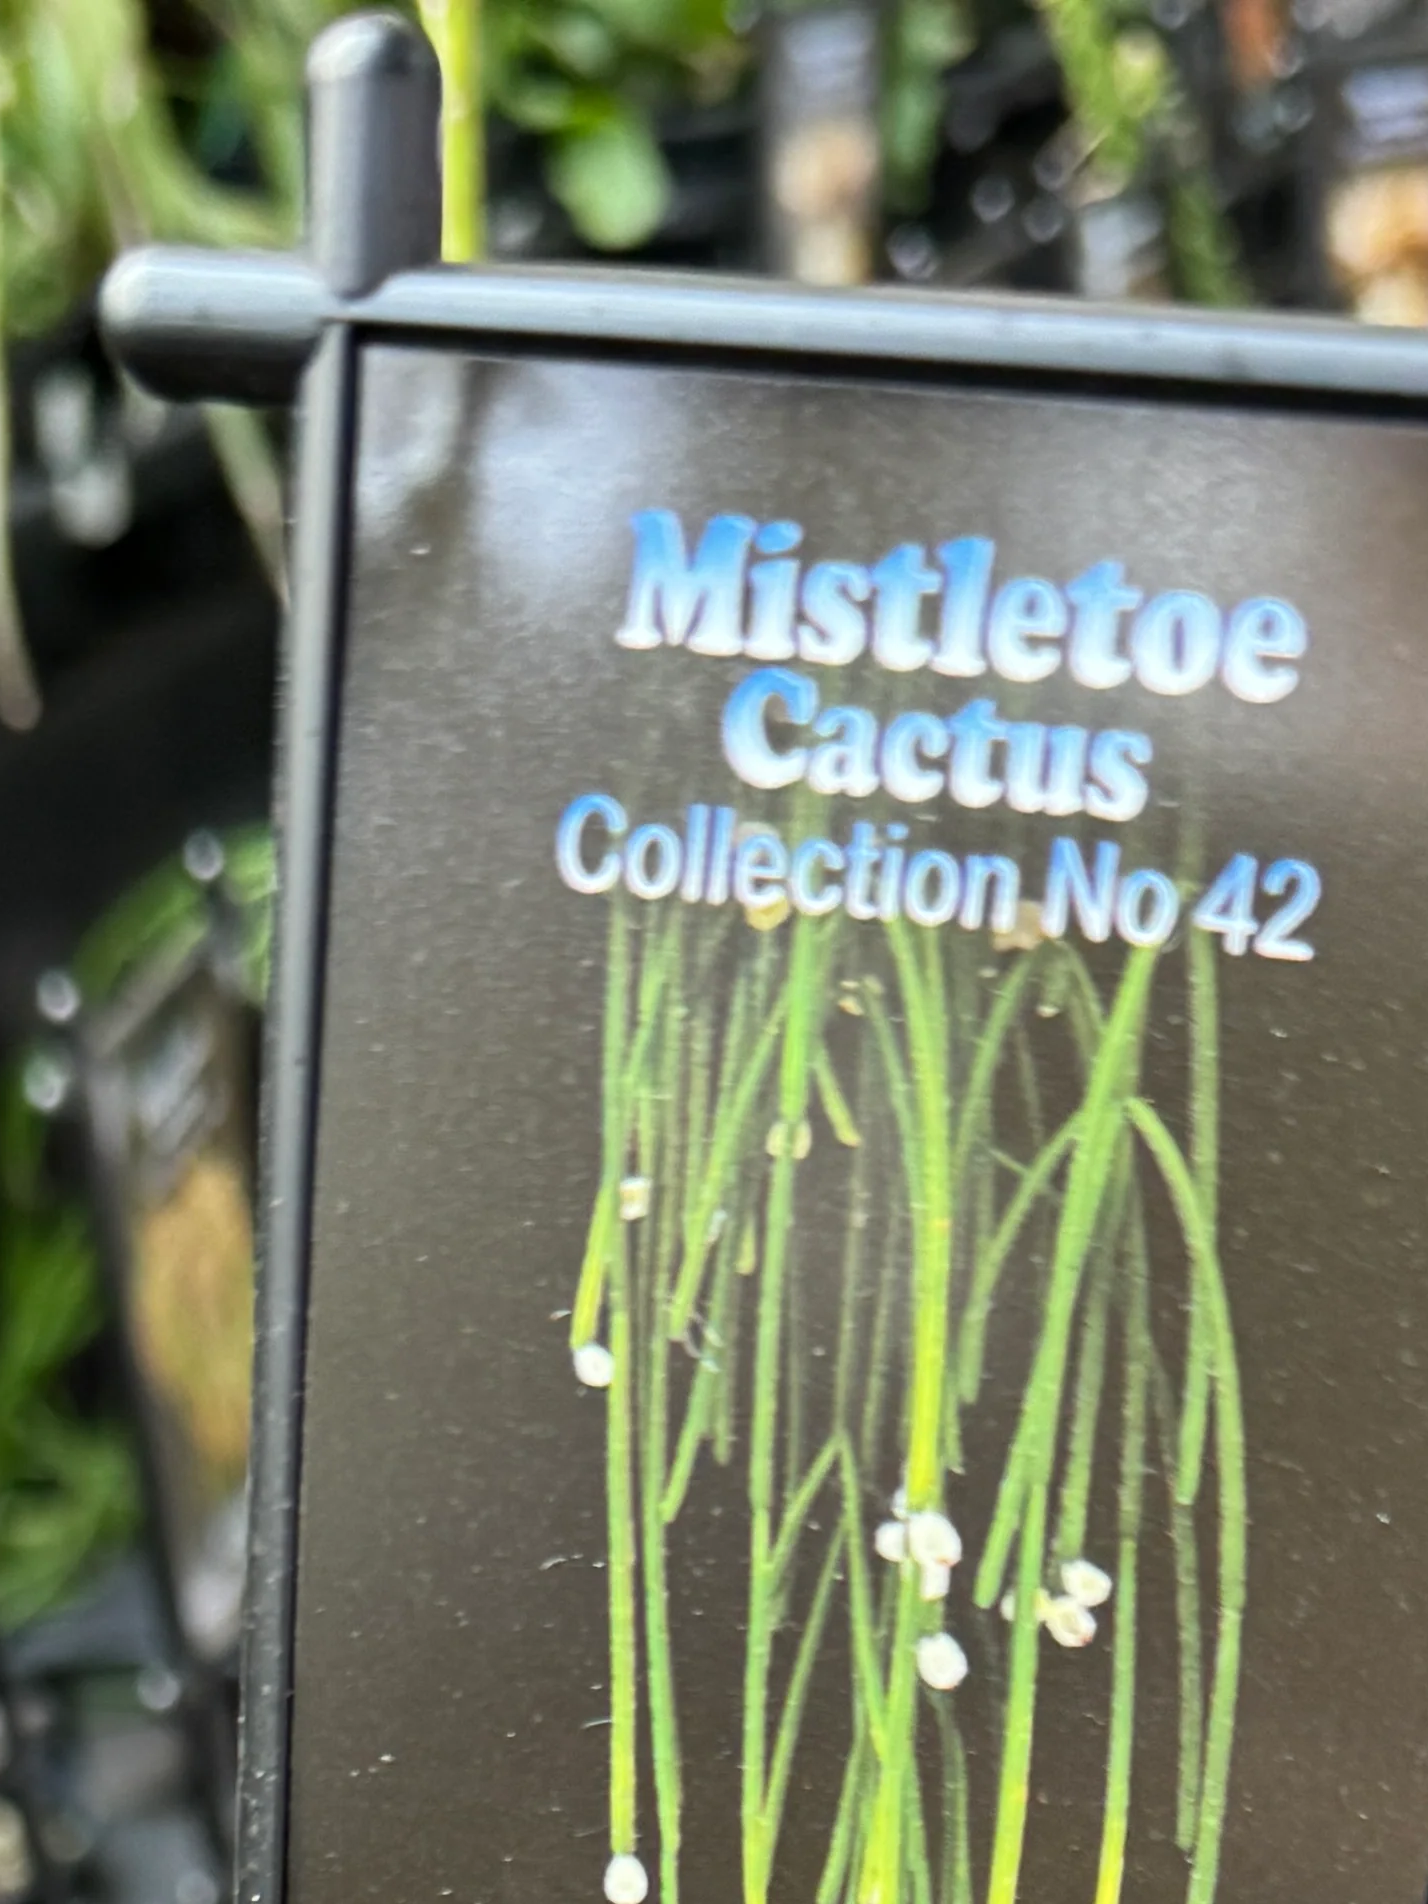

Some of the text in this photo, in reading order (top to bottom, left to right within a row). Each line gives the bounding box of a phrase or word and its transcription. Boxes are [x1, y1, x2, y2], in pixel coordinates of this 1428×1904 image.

[615, 508, 1308, 704] Mistletoe
[722, 667, 1154, 822] Cactus
[556, 793, 1020, 934] Collection
